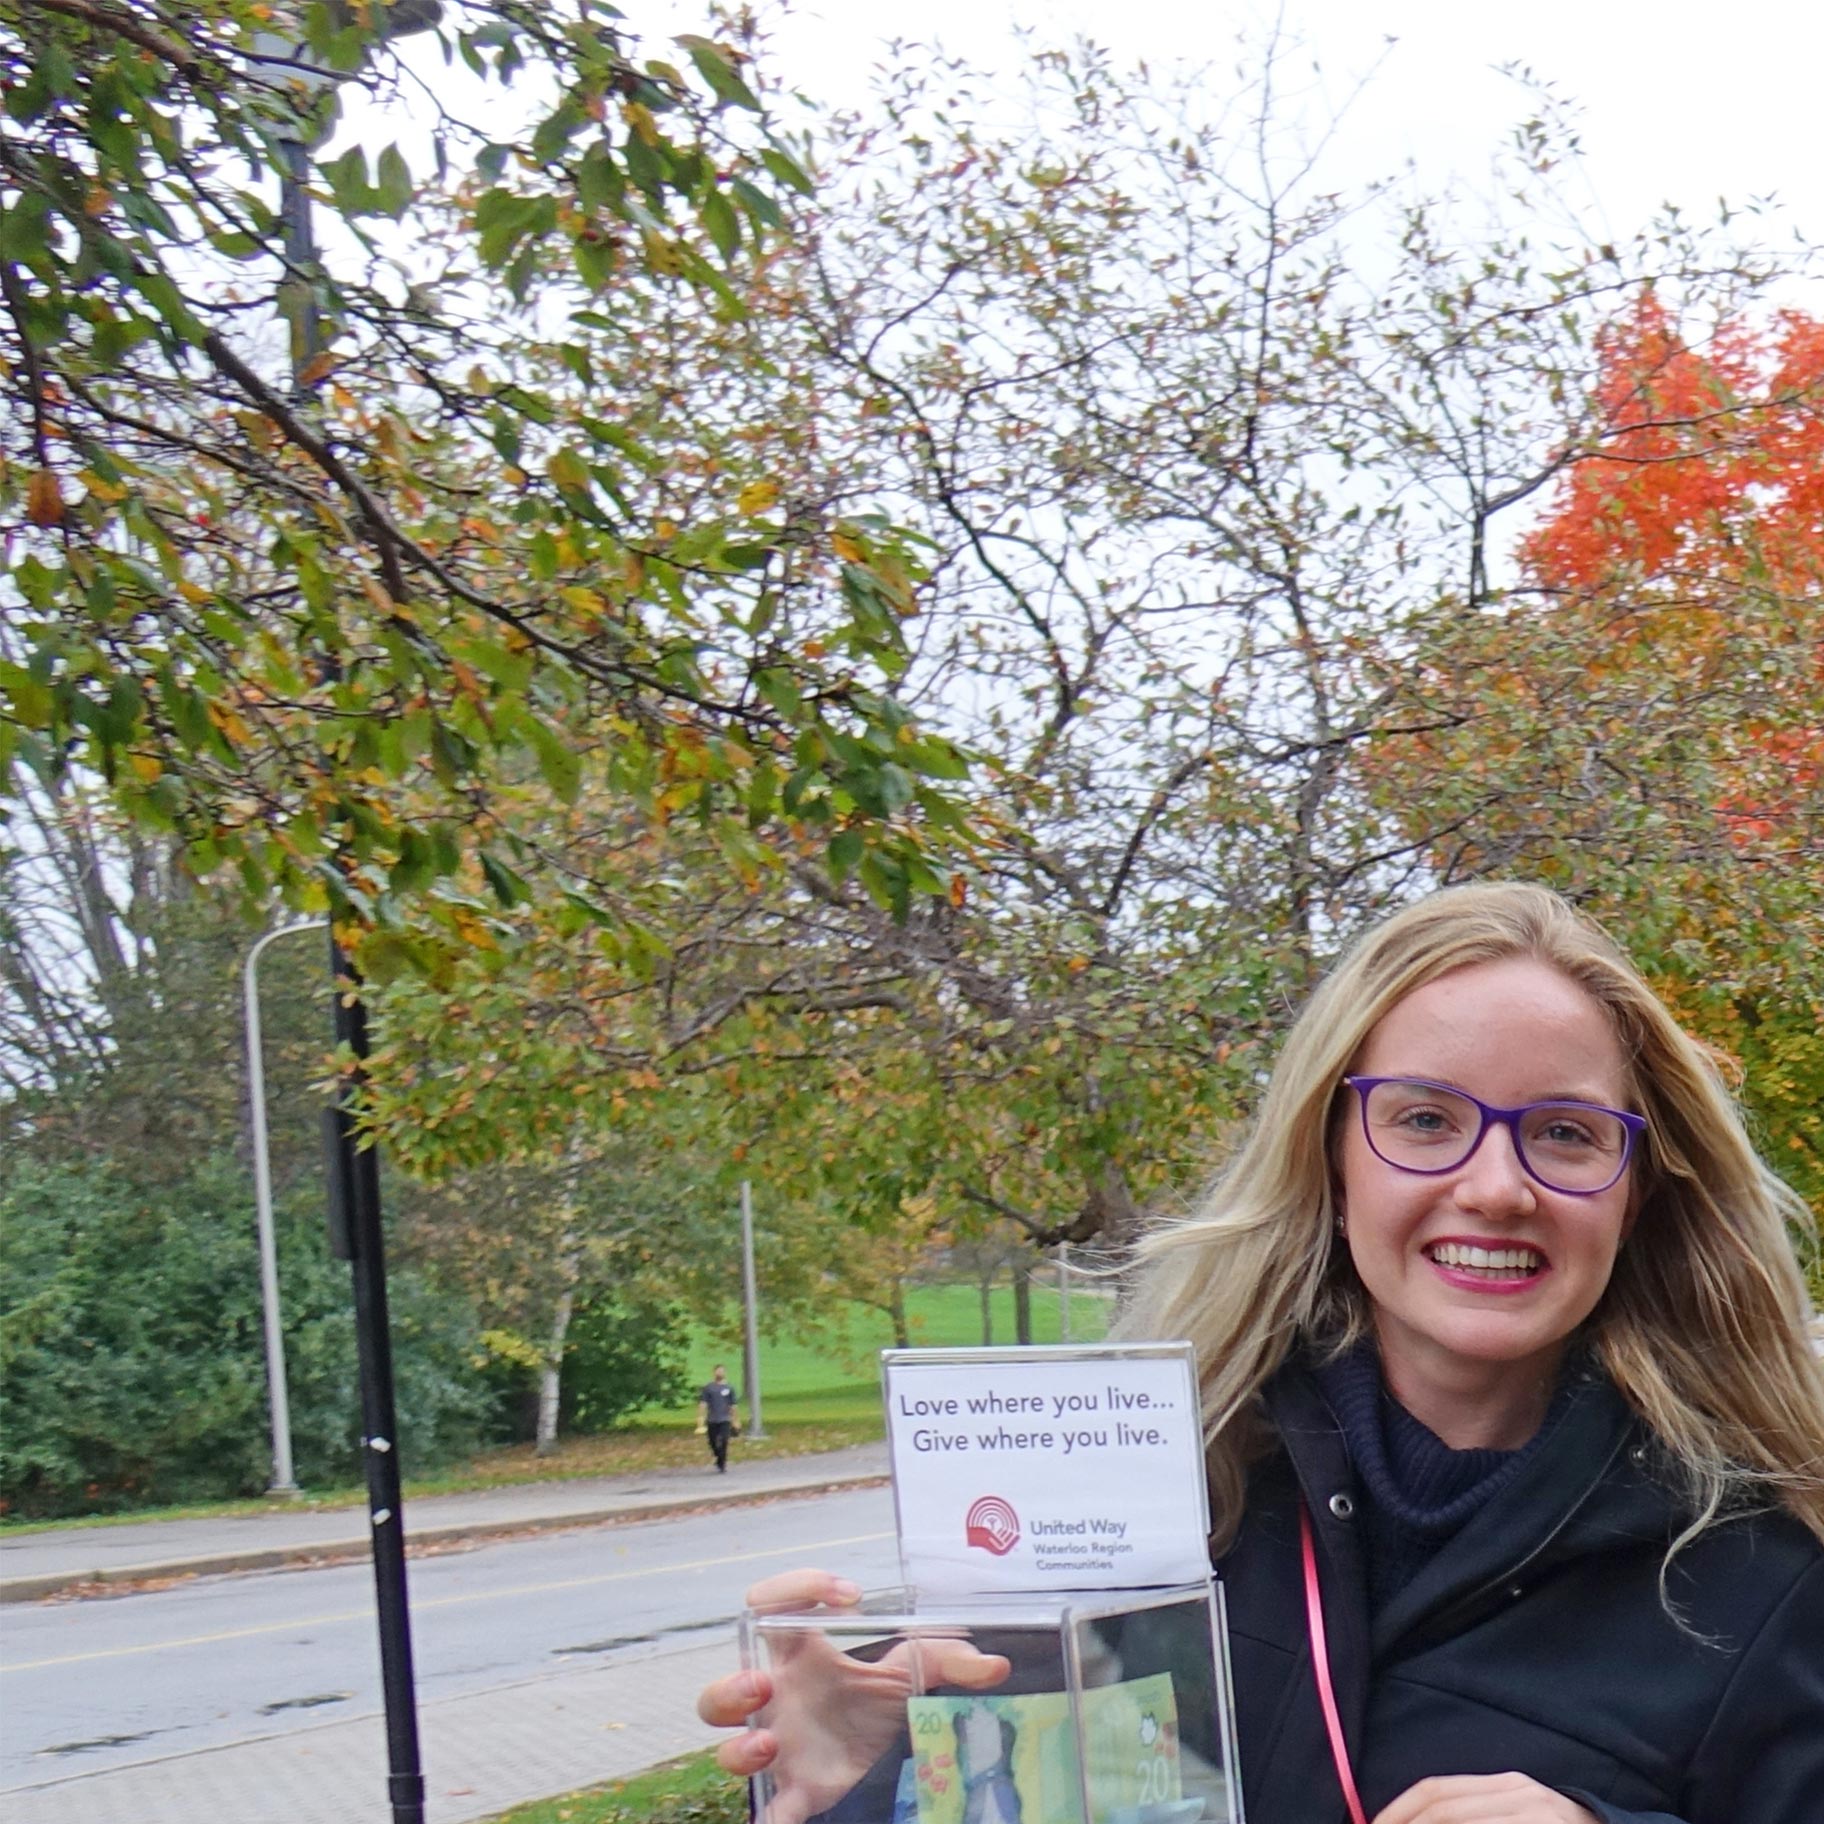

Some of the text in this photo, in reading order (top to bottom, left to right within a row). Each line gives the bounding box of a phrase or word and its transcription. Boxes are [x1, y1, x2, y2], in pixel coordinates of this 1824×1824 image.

[900, 1386, 1174, 1418] Love where you live...
[913, 1422, 1168, 1454] Give where you live.
[1030, 1519, 1127, 1538] United Way
[1033, 1542, 1133, 1556] Waterloo Region
[1036, 1558, 1114, 1571] Communities
[916, 1712, 941, 1735] 20
[1136, 1755, 1169, 1805] 20
